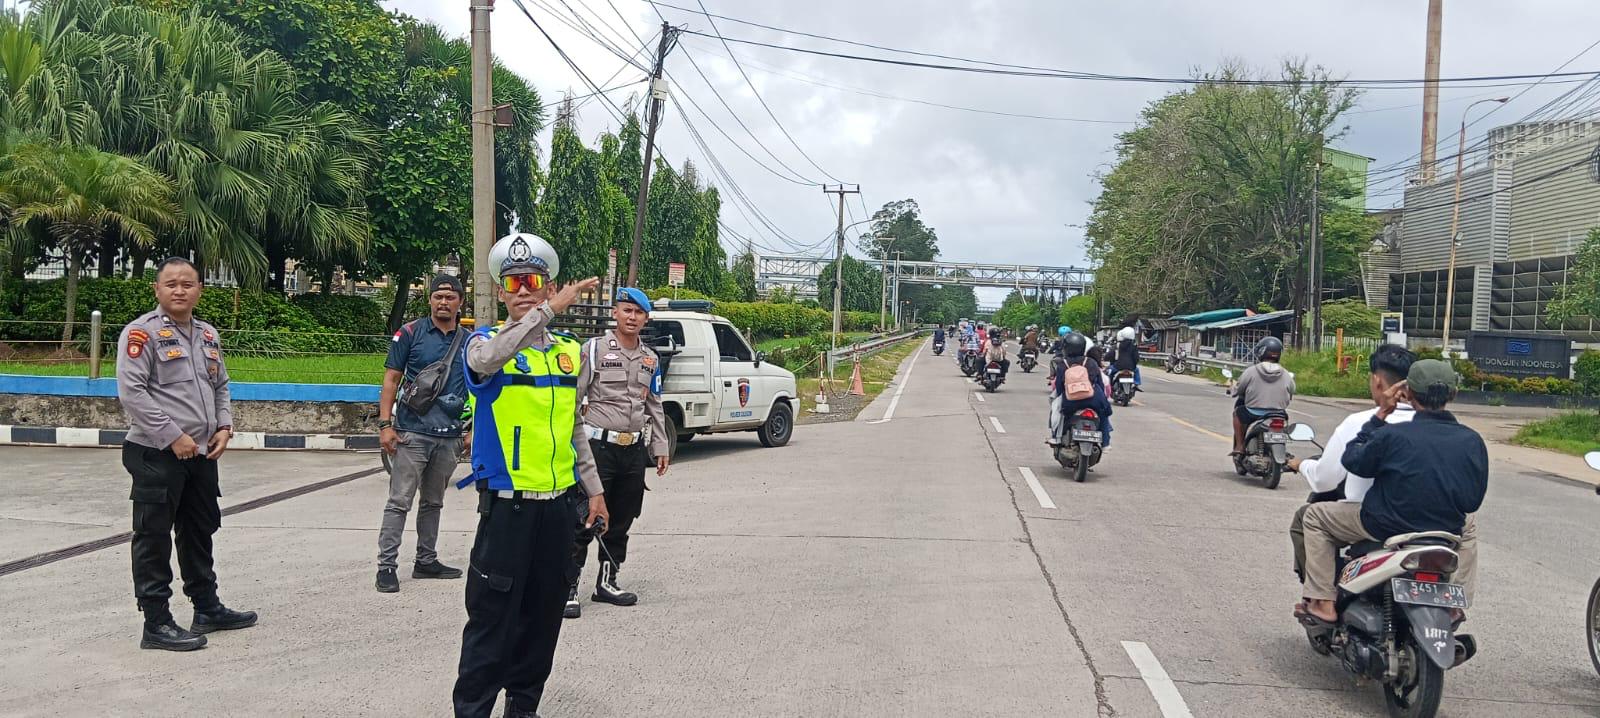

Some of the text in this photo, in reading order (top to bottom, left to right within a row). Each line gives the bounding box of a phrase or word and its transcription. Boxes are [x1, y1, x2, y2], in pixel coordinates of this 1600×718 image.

[1485, 358, 1519, 367] DONGJIN
[1520, 359, 1563, 369] INDONESIA
[1395, 580, 1464, 597] F 5451 UX
